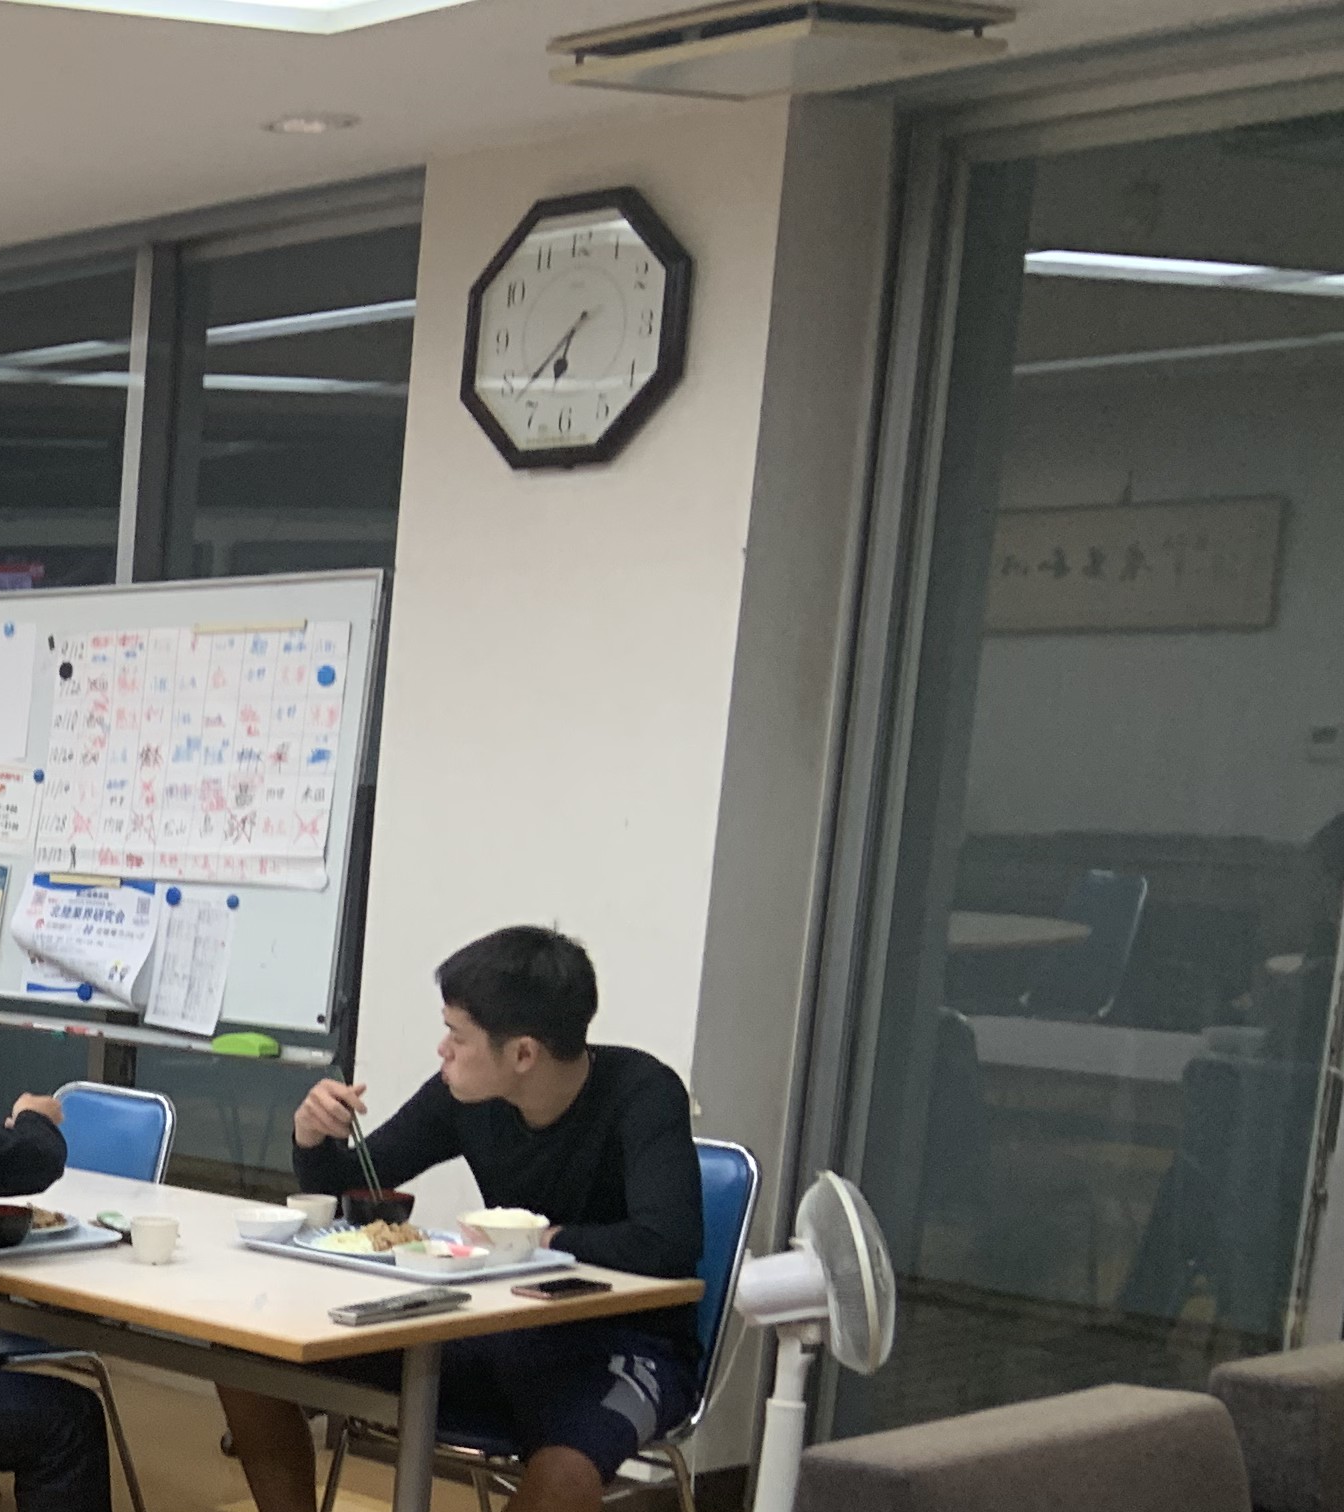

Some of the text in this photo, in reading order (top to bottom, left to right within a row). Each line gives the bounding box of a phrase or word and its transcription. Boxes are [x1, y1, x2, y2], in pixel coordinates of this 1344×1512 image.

[571, 231, 593, 258] 12
[537, 246, 553, 271] 11
[634, 261, 649, 289] 2
[507, 281, 525, 309] 10
[639, 310, 654, 337] 3
[496, 332, 510, 356] 9
[501, 372, 515, 399] 8
[525, 400, 538, 431] 7
[595, 393, 610, 420] 5
[558, 407, 572, 434] 6
[49, 905, 126, 924] 北陸業界研究会
